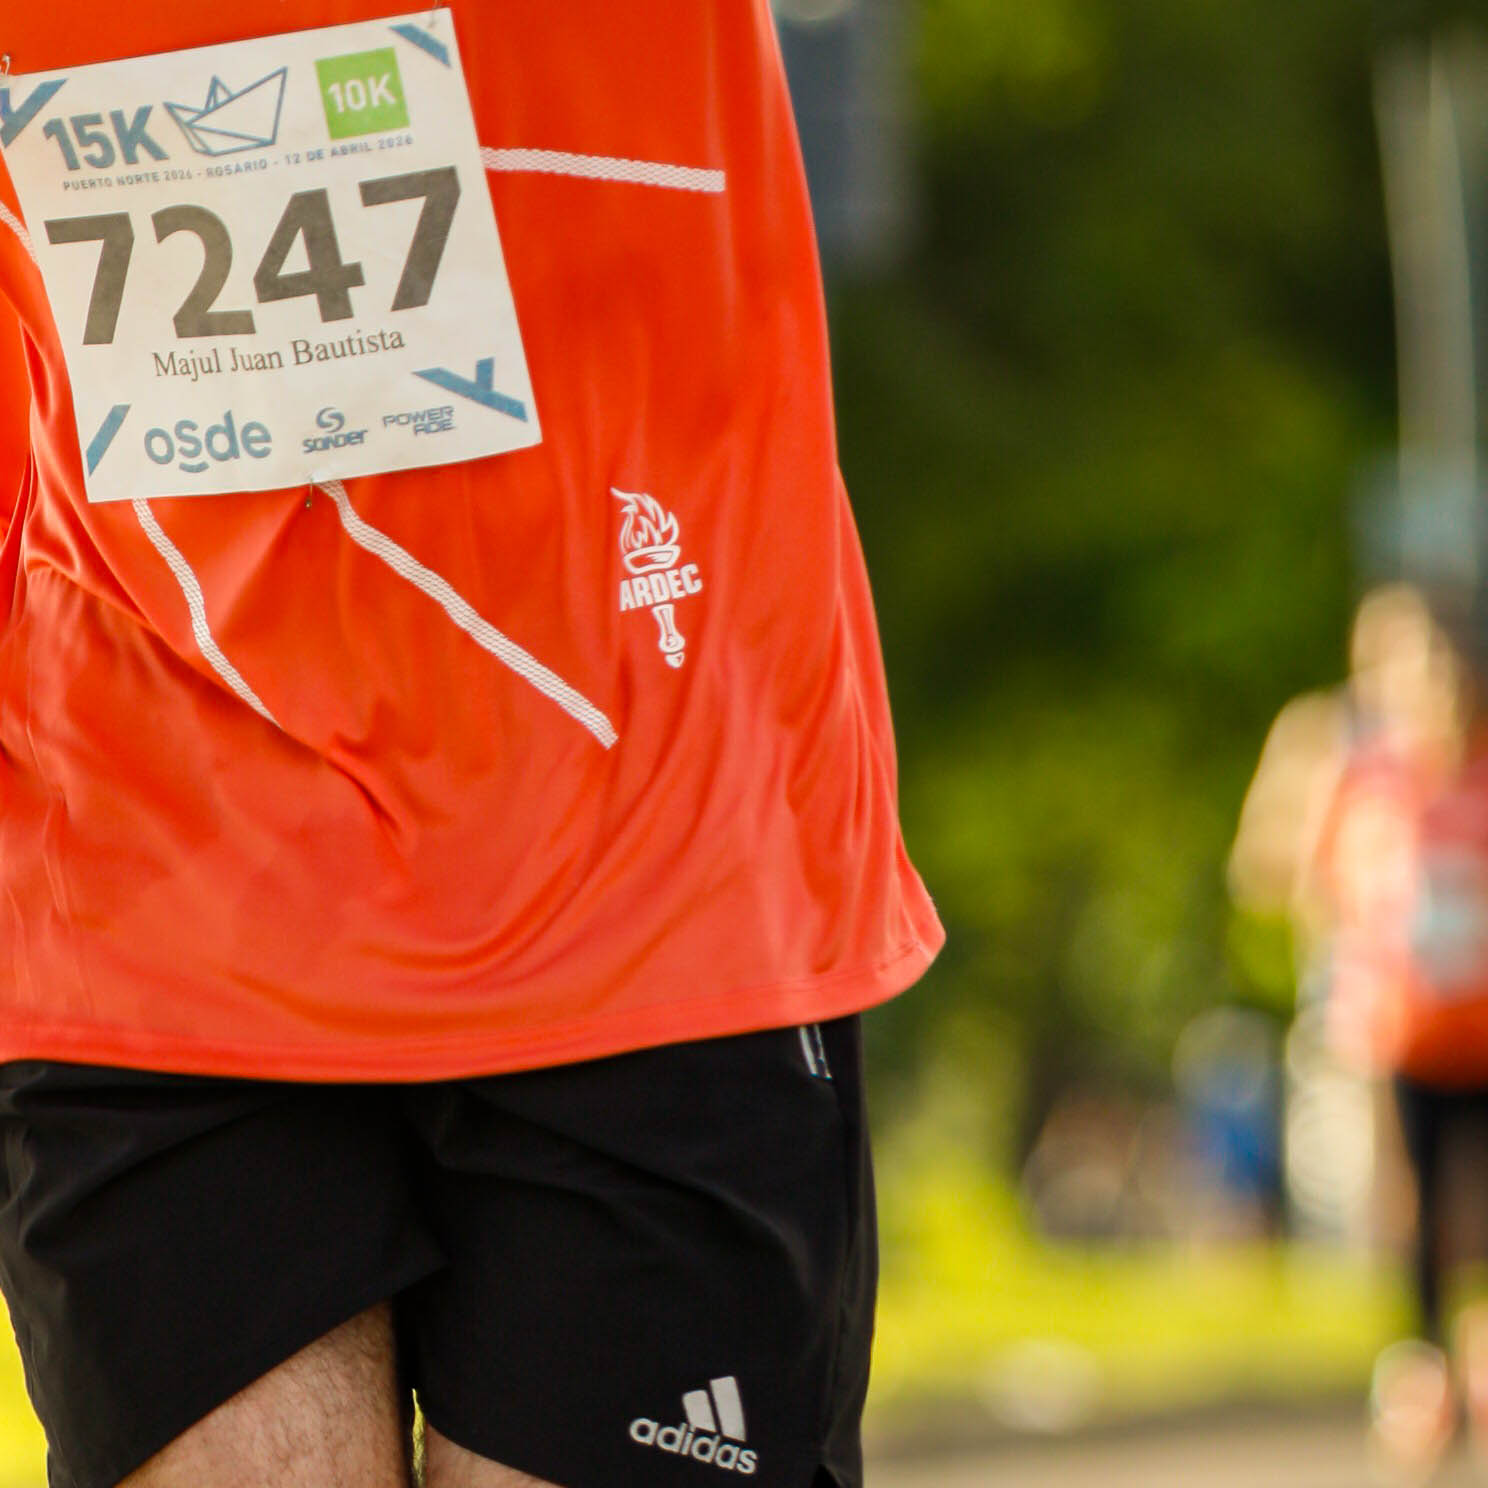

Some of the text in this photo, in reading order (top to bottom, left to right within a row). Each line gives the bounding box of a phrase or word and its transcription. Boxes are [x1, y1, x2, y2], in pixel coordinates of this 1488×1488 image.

[328, 72, 396, 113] 10K
[42, 104, 169, 171] 15K
[63, 176, 113, 191] PUERTO
[116, 171, 161, 186] NORTE
[206, 158, 267, 179] ROSARIO
[286, 152, 300, 165] 12
[307, 148, 324, 161] DE
[331, 140, 372, 157] ABRIL
[44, 165, 461, 345] 7247
[152, 329, 406, 382] Majul Juan Bautista
[144, 409, 273, 466] osde
[383, 406, 455, 428] POWER
[619, 564, 703, 611] ARDEC
[628, 1417, 759, 1475] adidas
